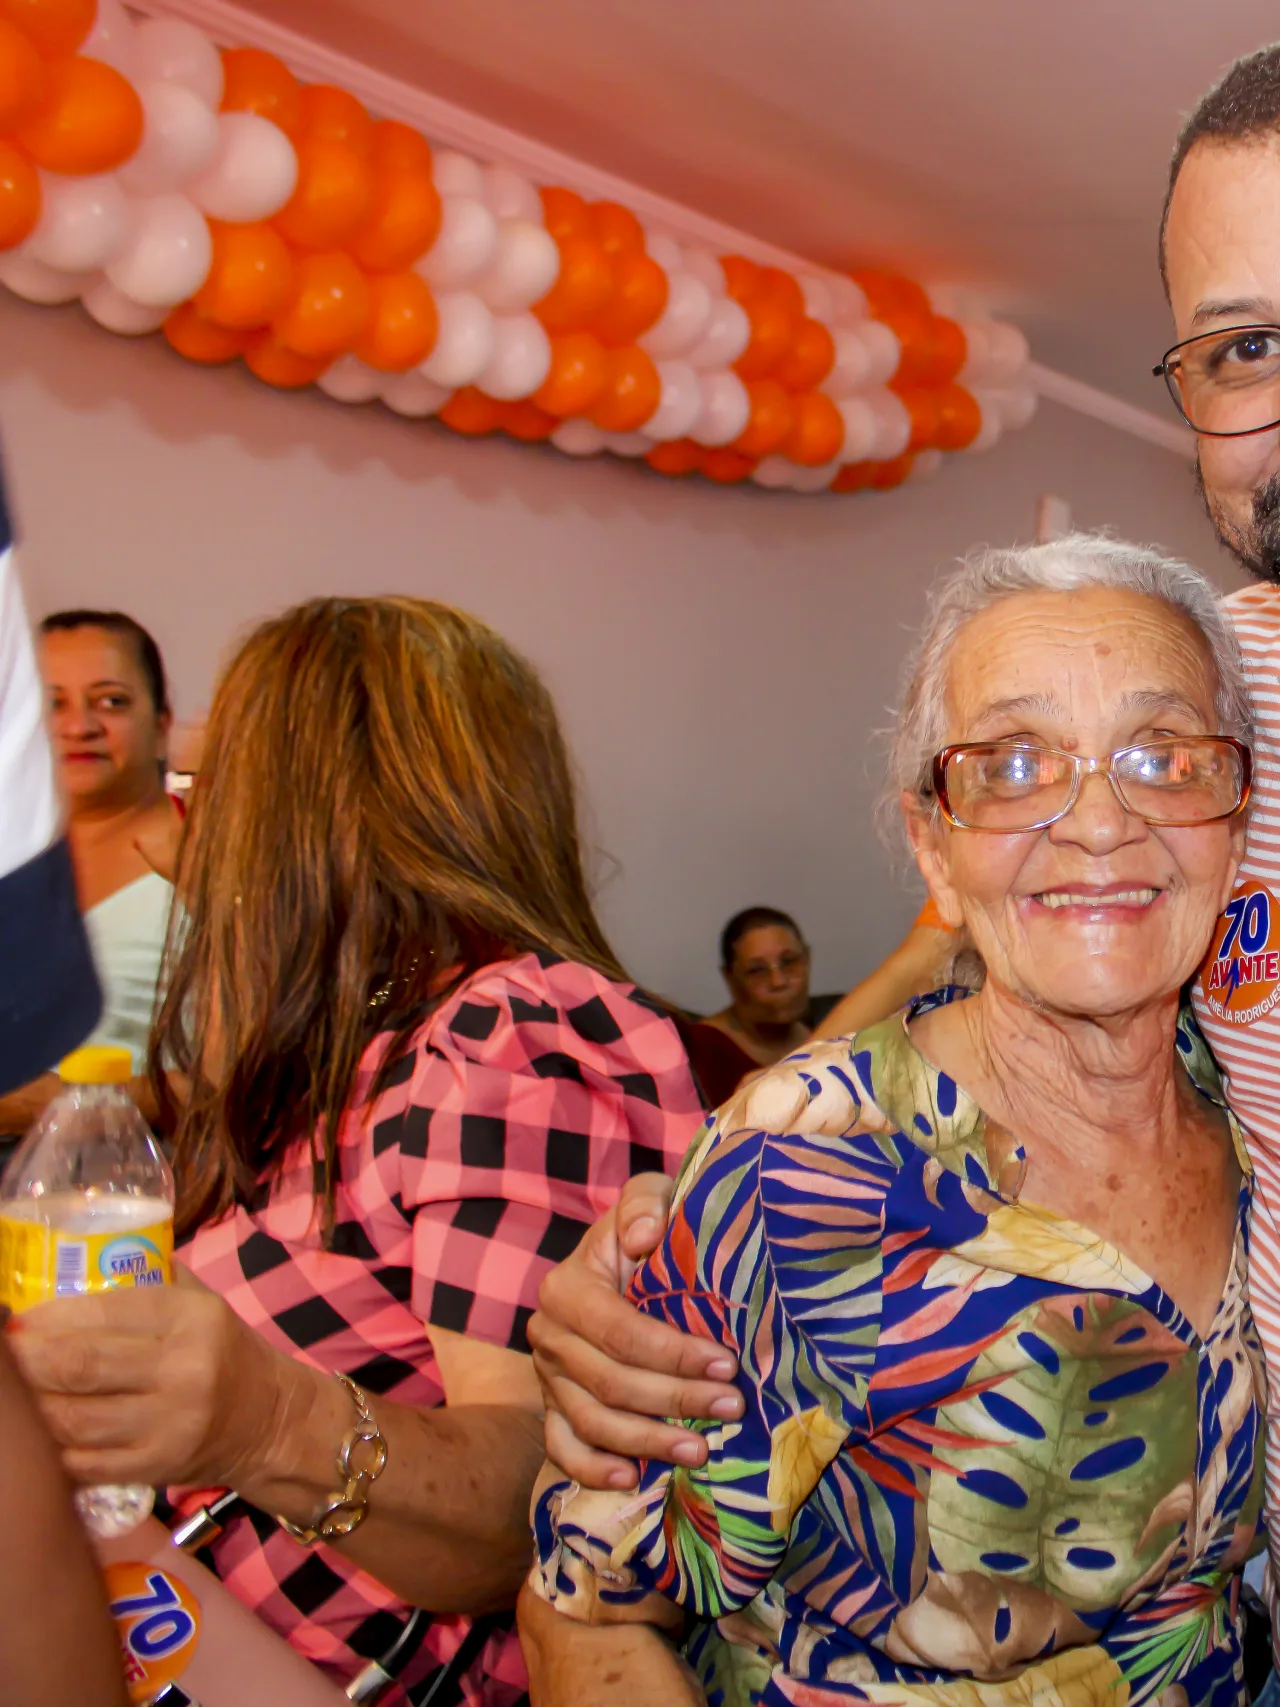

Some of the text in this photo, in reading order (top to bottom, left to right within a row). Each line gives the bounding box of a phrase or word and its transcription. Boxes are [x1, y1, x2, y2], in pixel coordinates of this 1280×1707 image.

[1218, 891, 1270, 961] 70
[1208, 951, 1280, 1008] AVANTE
[1207, 994, 1233, 1023] AMÉLIA
[111, 1255, 147, 1275] SANTA
[109, 1571, 196, 1663] 70
